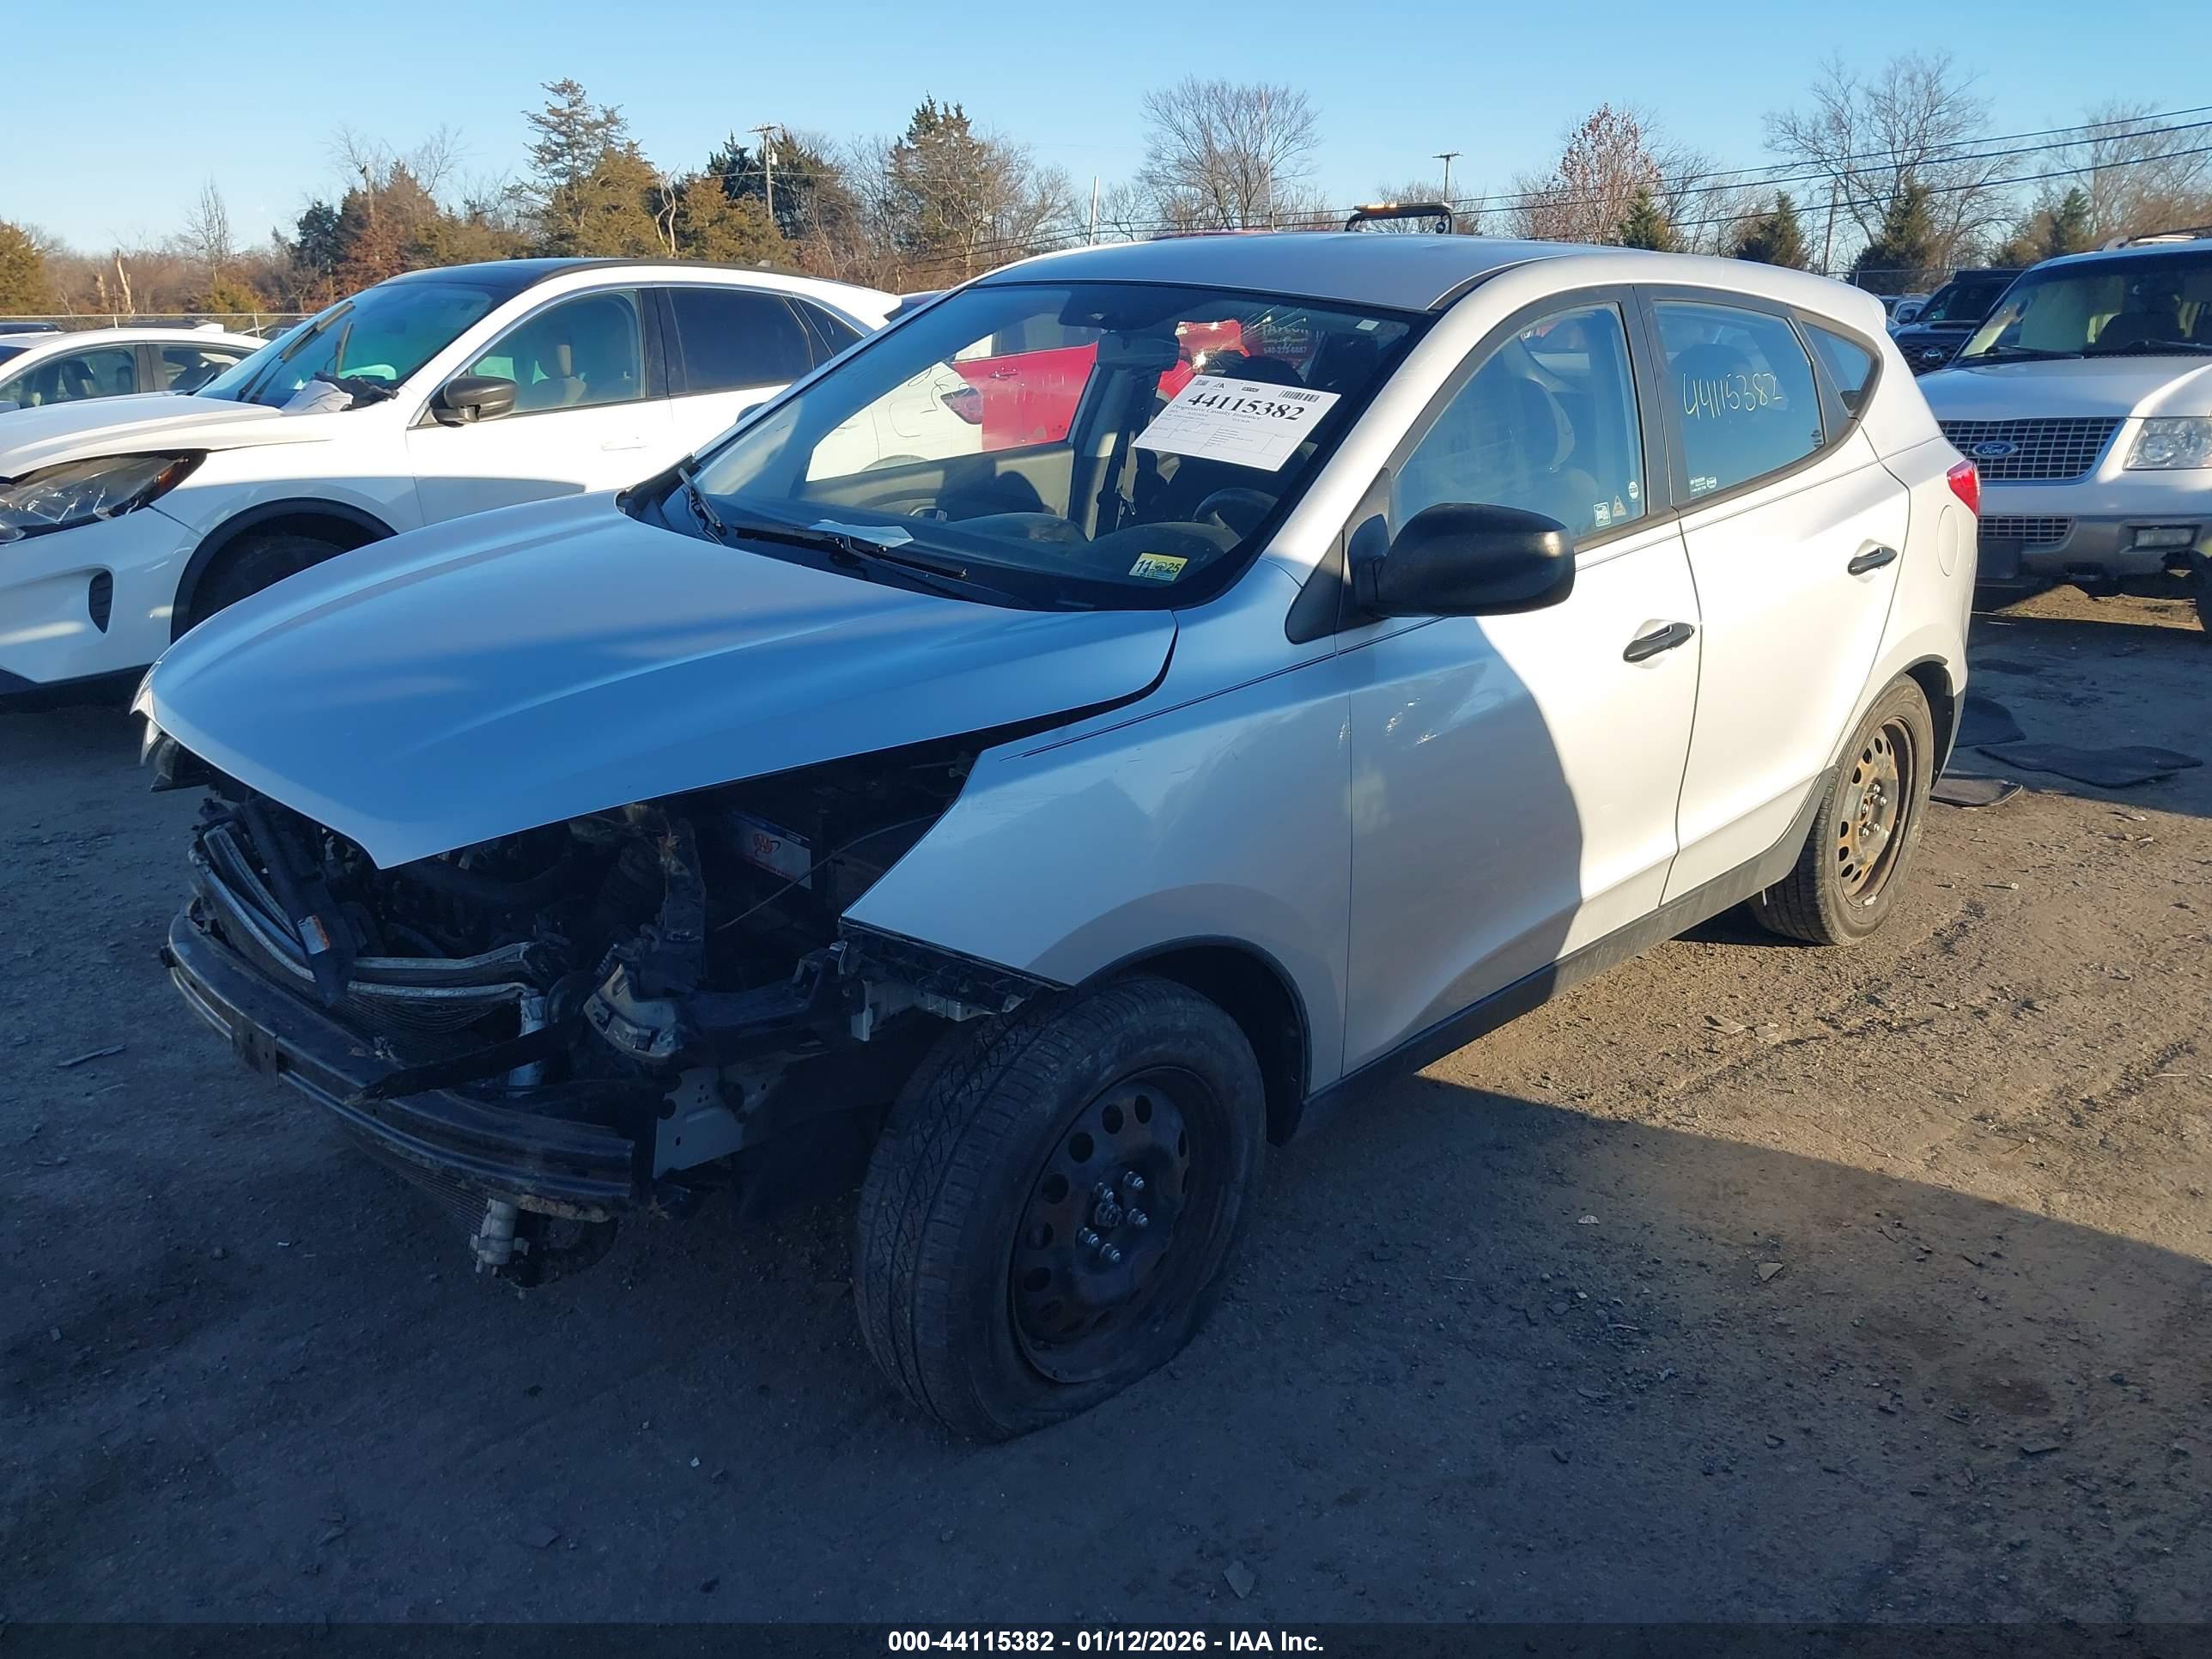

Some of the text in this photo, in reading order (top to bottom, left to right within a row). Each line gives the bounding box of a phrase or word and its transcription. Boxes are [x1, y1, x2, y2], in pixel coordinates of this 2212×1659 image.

[1188, 392, 1305, 421] 44115382
[1683, 373, 1784, 420] 44115382
[1981, 443, 2005, 455] Ford
[1137, 559, 1182, 574] 11 25
